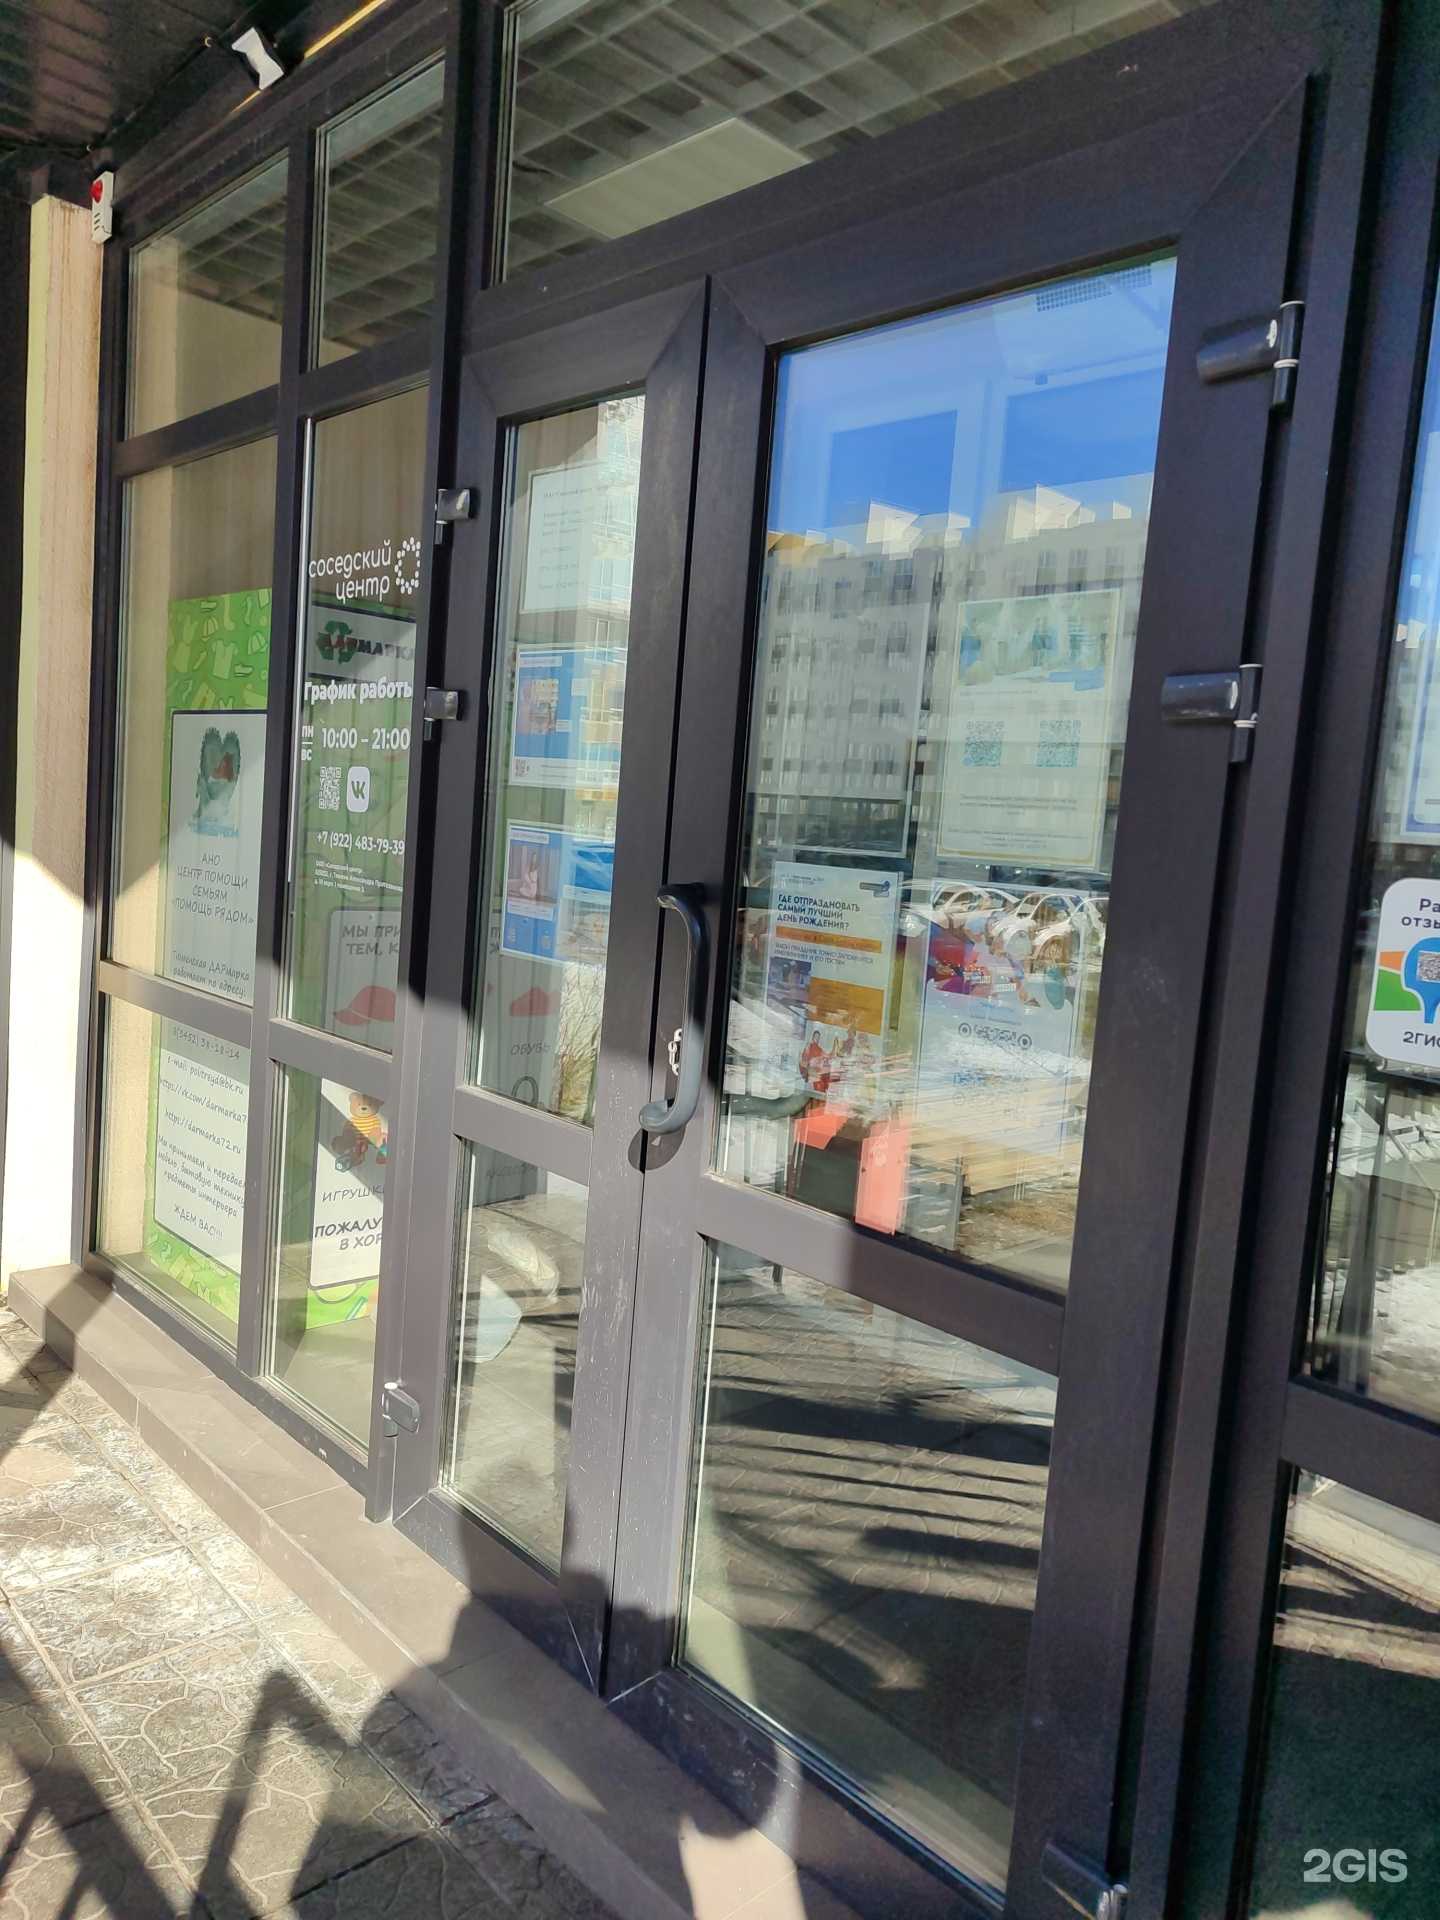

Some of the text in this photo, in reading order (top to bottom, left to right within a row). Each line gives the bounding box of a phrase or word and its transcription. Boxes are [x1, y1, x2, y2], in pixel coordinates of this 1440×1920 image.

[309, 539, 391, 579] соседский
[336, 576, 390, 604] центр
[304, 679, 356, 705] График
[321, 728, 358, 749] 10:00
[371, 727, 410, 750] 21:00
[317, 831, 405, 856] +7 (922) 483-79-39
[201, 853, 221, 866] АНО
[204, 870, 249, 889] ПОМОЩИ
[192, 884, 228, 902] СЕМЬЯМ
[777, 903, 843, 920] САМЫЙ ЛУЧШИЙ
[778, 894, 860, 912] ГДЕ ОТПРАЗДНОВАТЬ
[342, 924, 369, 939] МЫ
[777, 914, 849, 931] ДЕНЬ РОЖДЕНИЯ?
[314, 1216, 383, 1238] ПОЖАЛУ
[339, 1238, 351, 1251] В
